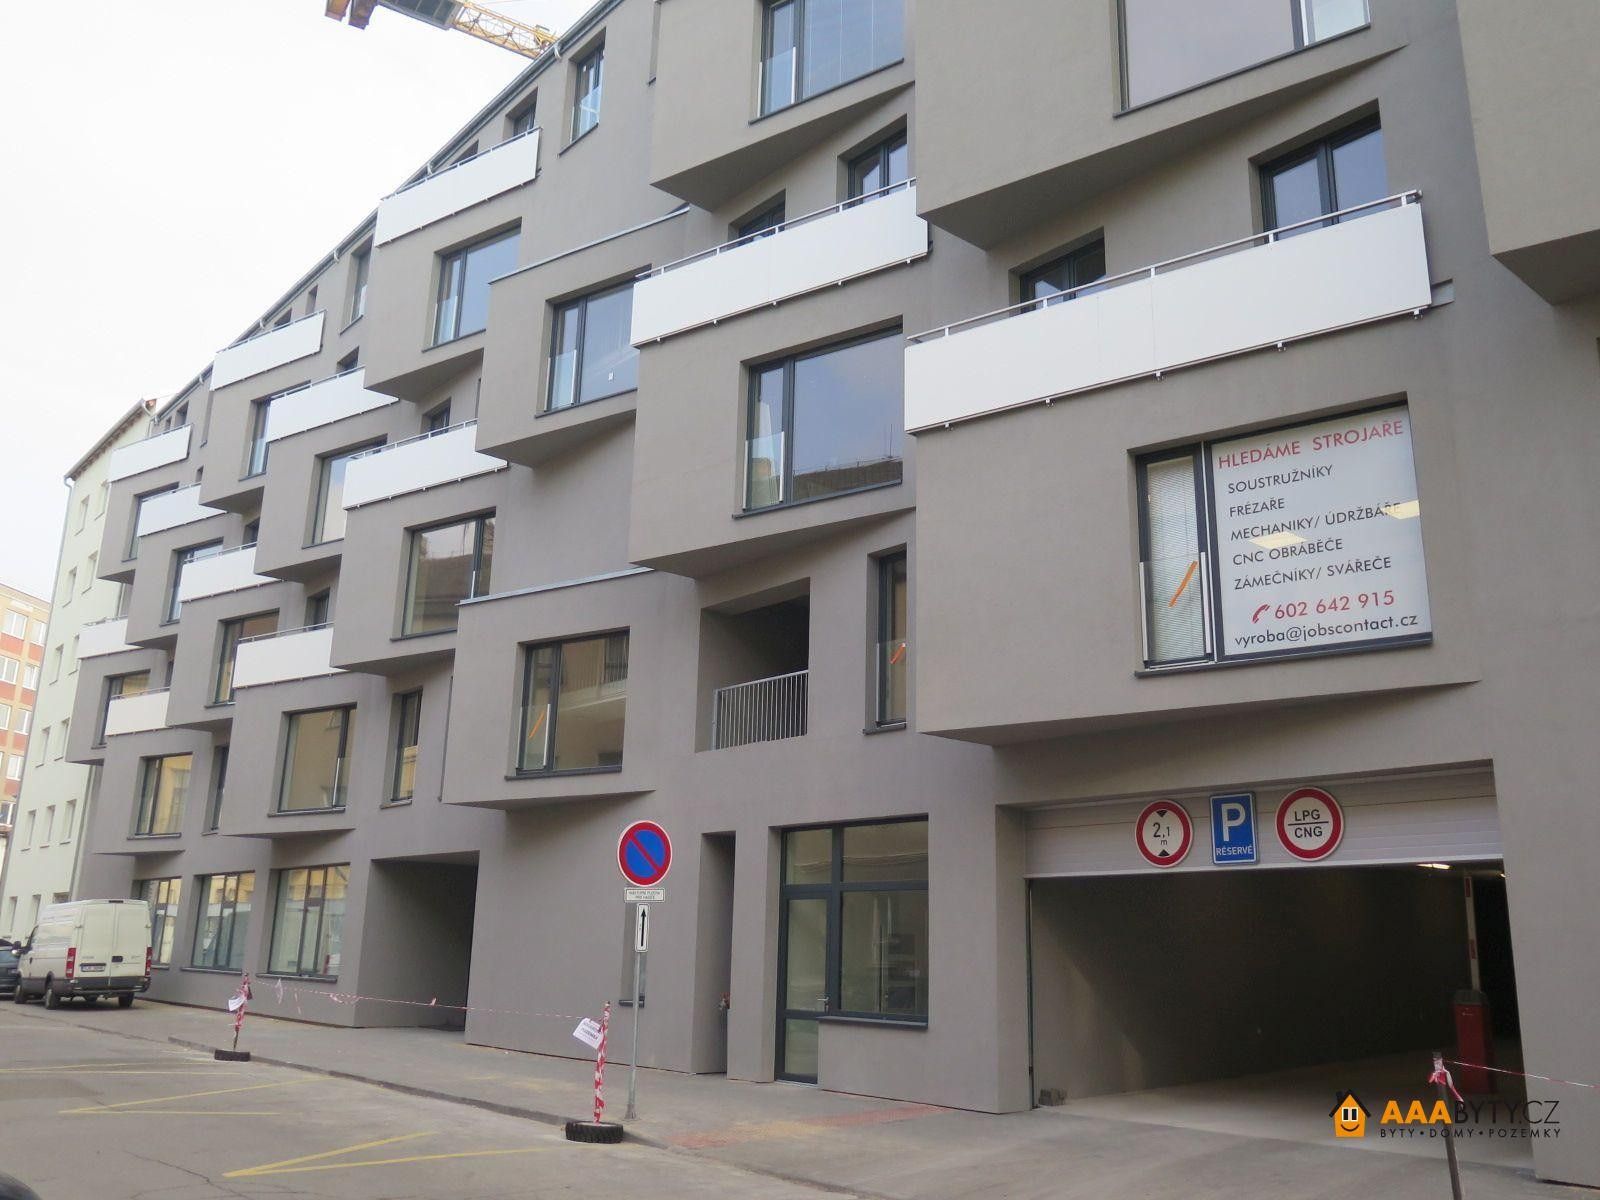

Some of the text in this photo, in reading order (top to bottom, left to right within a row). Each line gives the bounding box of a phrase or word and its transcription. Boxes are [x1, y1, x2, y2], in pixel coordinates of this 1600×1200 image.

[1218, 420, 1404, 469] HLEDÁME STROJAŘE
[1228, 464, 1333, 494] SOUSTRUŽNÍKY
[1229, 497, 1285, 517] FRÉZAŘE
[1232, 538, 1343, 566] CNC OBRÁBĚČE
[1327, 556, 1392, 577] SVÁŘEČE
[1274, 590, 1394, 620] 602 642 915
[1234, 614, 1418, 649] vyroba@jobscontact.cz
[1221, 802, 1246, 842] P
[1294, 809, 1321, 822] LPG
[1152, 822, 1170, 838] 2,1
[1294, 826, 1323, 838] CNG
